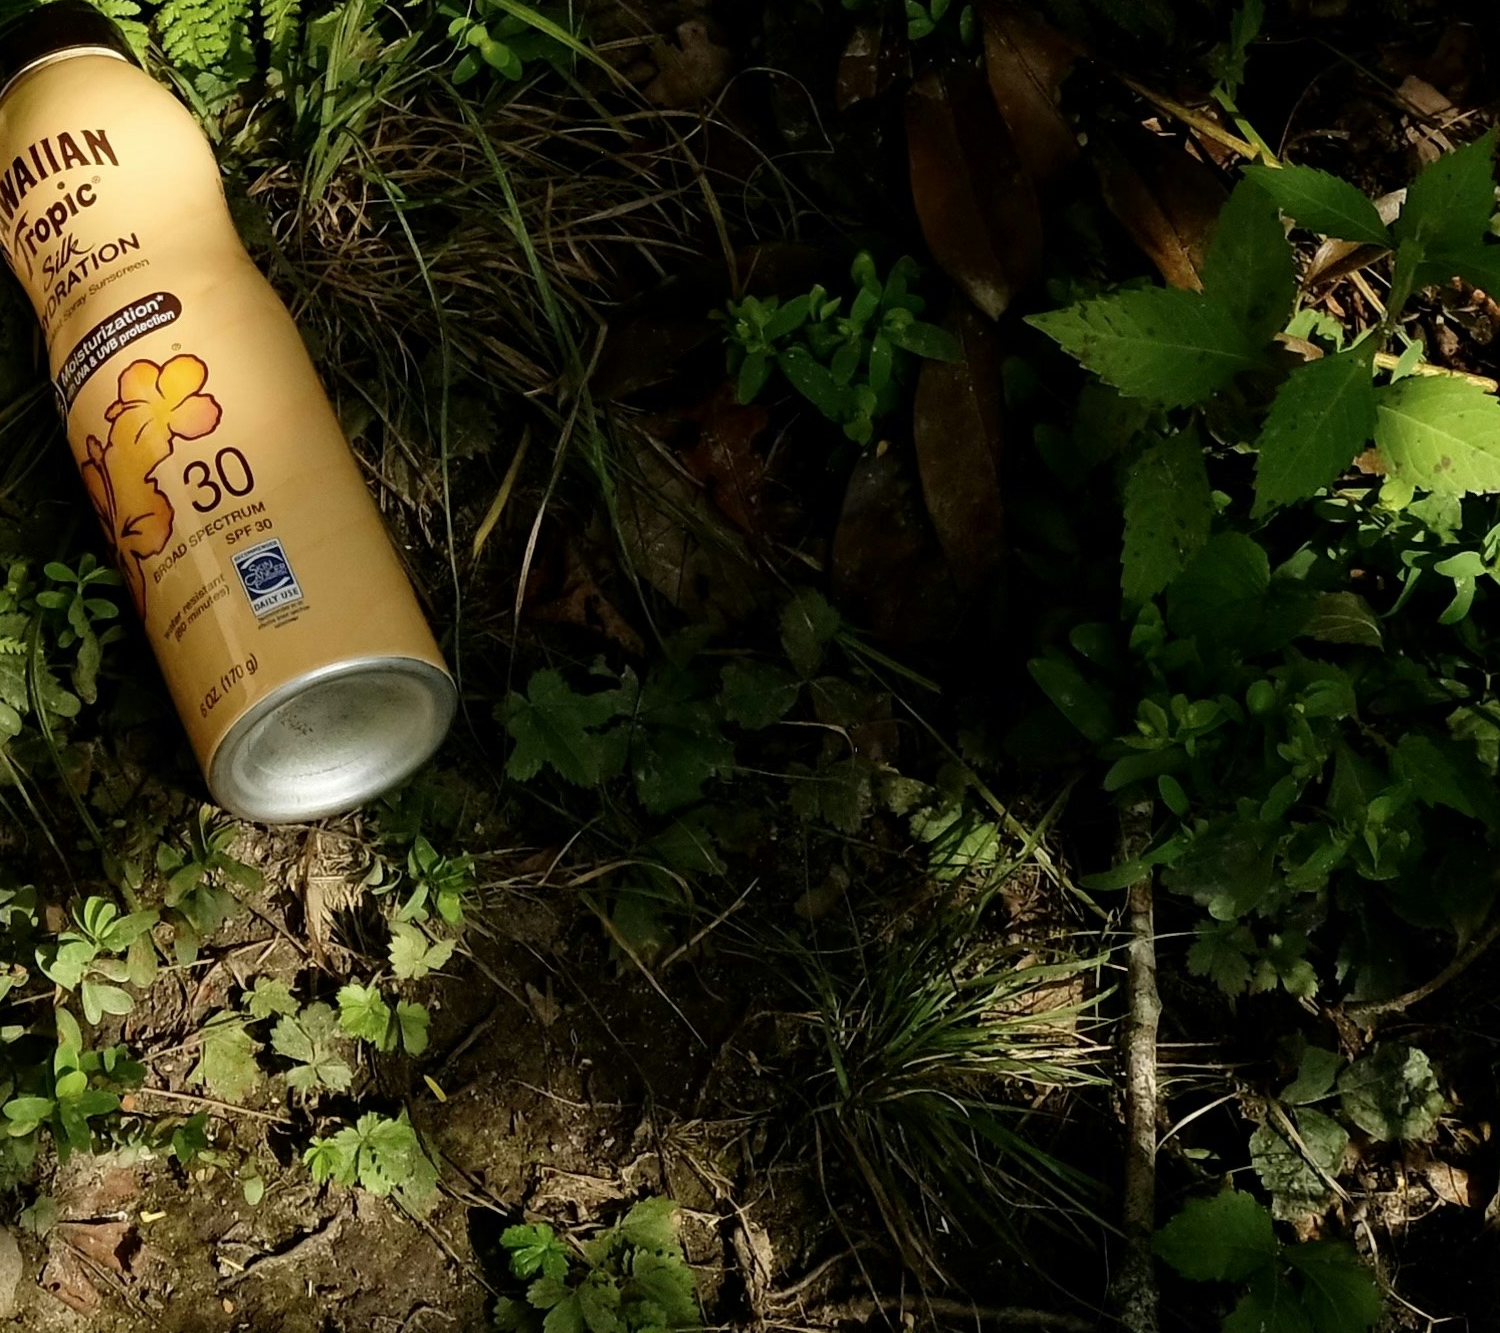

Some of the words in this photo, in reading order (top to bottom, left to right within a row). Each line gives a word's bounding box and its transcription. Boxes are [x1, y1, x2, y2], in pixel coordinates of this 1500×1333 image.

[42, 232, 95, 293] Silk
[42, 233, 140, 331] YDRATION
[88, 258, 150, 296] Sunscreen
[74, 364, 91, 386] UVA
[89, 355, 98, 368] &
[96, 338, 118, 360] UVB
[119, 310, 176, 347] protection
[183, 447, 255, 513] 30
[154, 543, 187, 583] BROAD
[188, 501, 266, 548] SPECTRUM
[225, 524, 252, 545] SPF
[256, 518, 273, 533] 30
[248, 559, 274, 573] SKIN
[183, 573, 225, 614] resistant
[187, 584, 230, 624] minutes)
[254, 595, 278, 612] DAILY
[281, 586, 299, 599] USE
[200, 702, 208, 719] 6
[206, 685, 223, 711] OZ.
[220, 664, 244, 693] (170
[245, 653, 258, 675] g)
